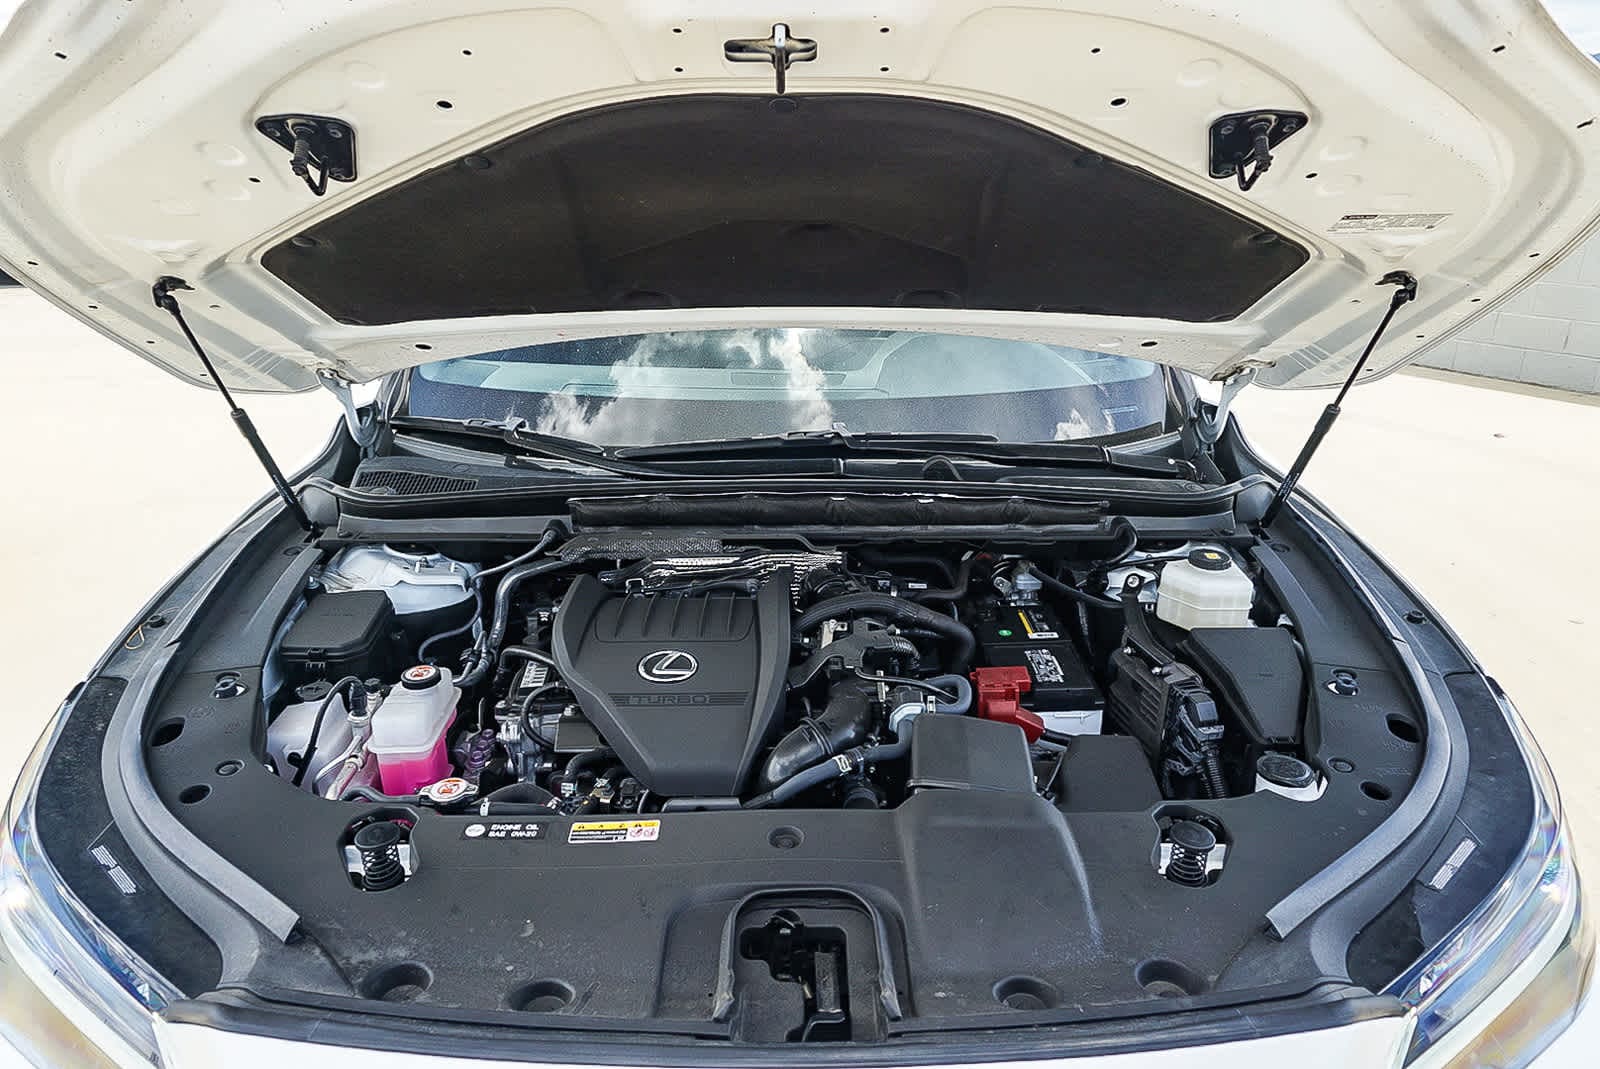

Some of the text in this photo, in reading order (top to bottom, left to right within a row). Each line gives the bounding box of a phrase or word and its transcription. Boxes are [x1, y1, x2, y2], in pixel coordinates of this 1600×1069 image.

[631, 694, 708, 704] TURBO
[490, 823, 522, 831] ENGINE
[525, 823, 539, 831] OIL
